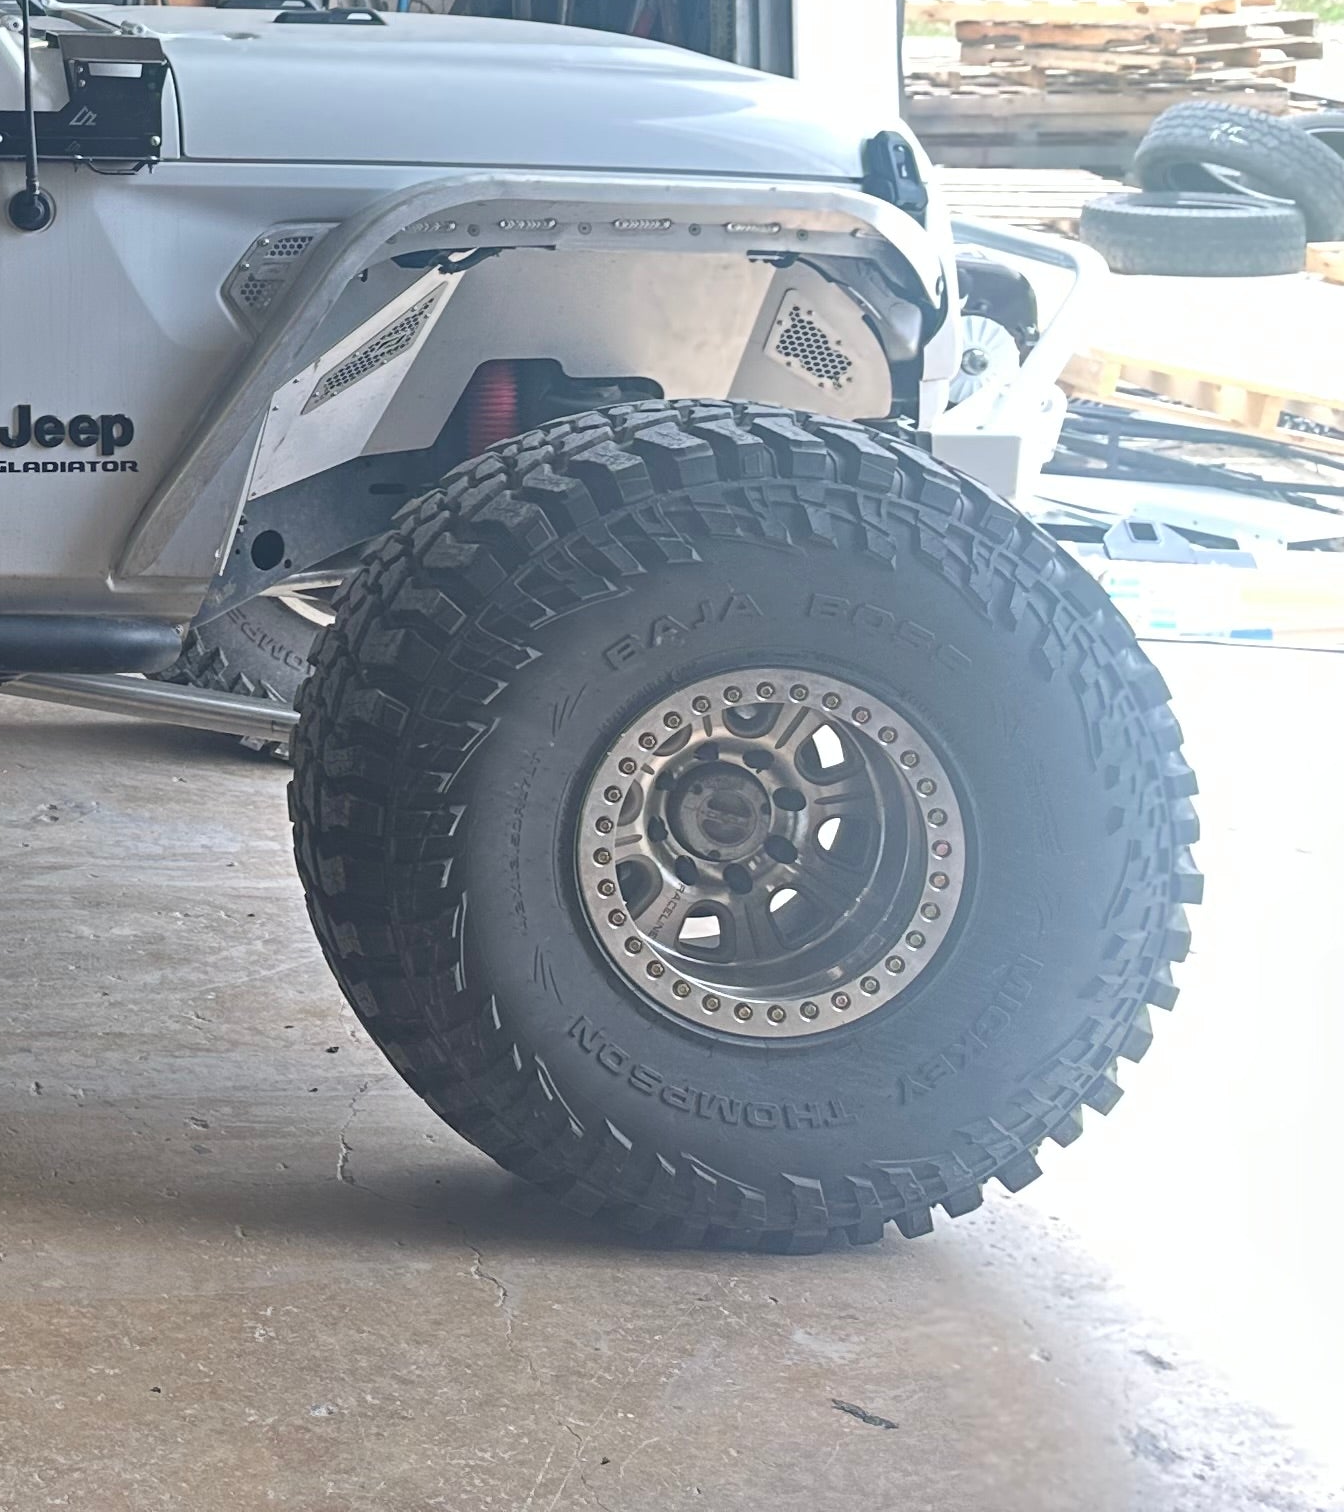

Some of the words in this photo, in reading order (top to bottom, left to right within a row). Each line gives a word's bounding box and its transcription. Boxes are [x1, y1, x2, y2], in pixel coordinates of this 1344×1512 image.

[601, 591, 766, 672] BAJA
[646, 881, 687, 939] RACELINE
[567, 1013, 860, 1131] THOMPSON
[892, 953, 1045, 1105] MICKEY
